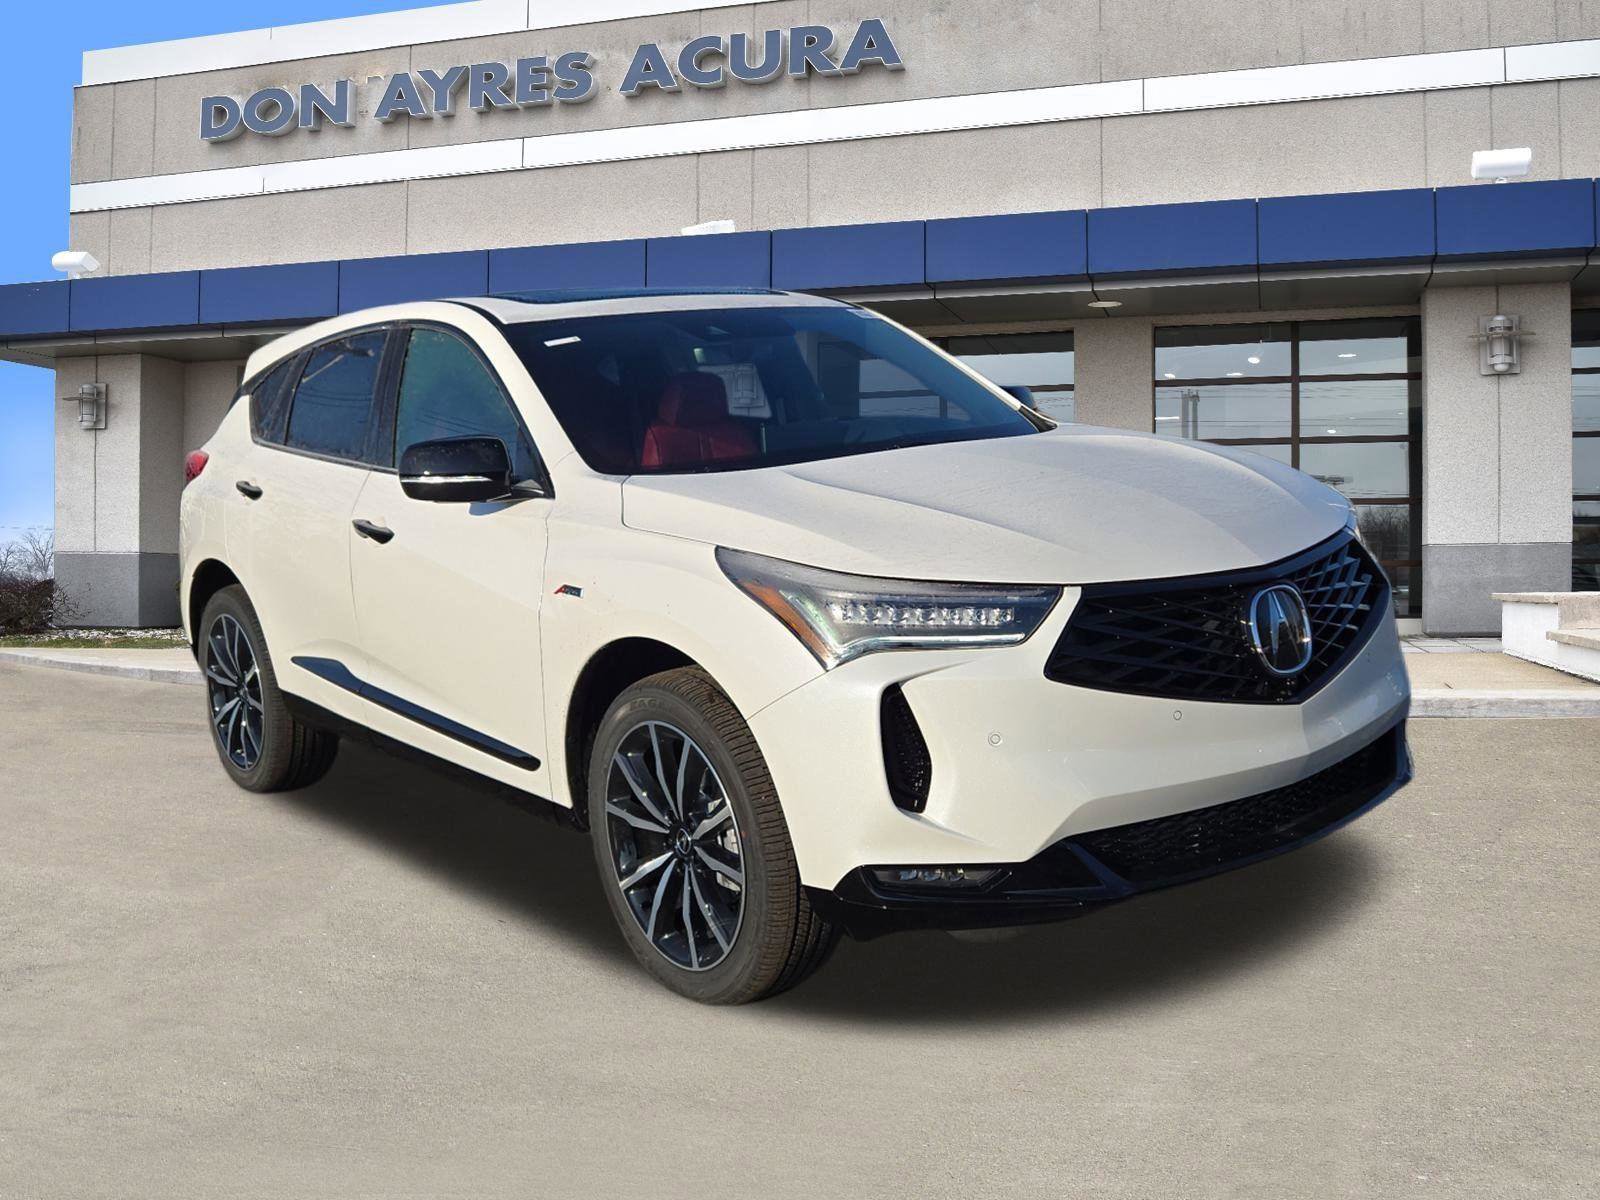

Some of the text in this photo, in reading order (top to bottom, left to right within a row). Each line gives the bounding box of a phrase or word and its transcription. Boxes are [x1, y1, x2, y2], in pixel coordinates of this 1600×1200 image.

[200, 18, 904, 142] DON AYRES ACURA
